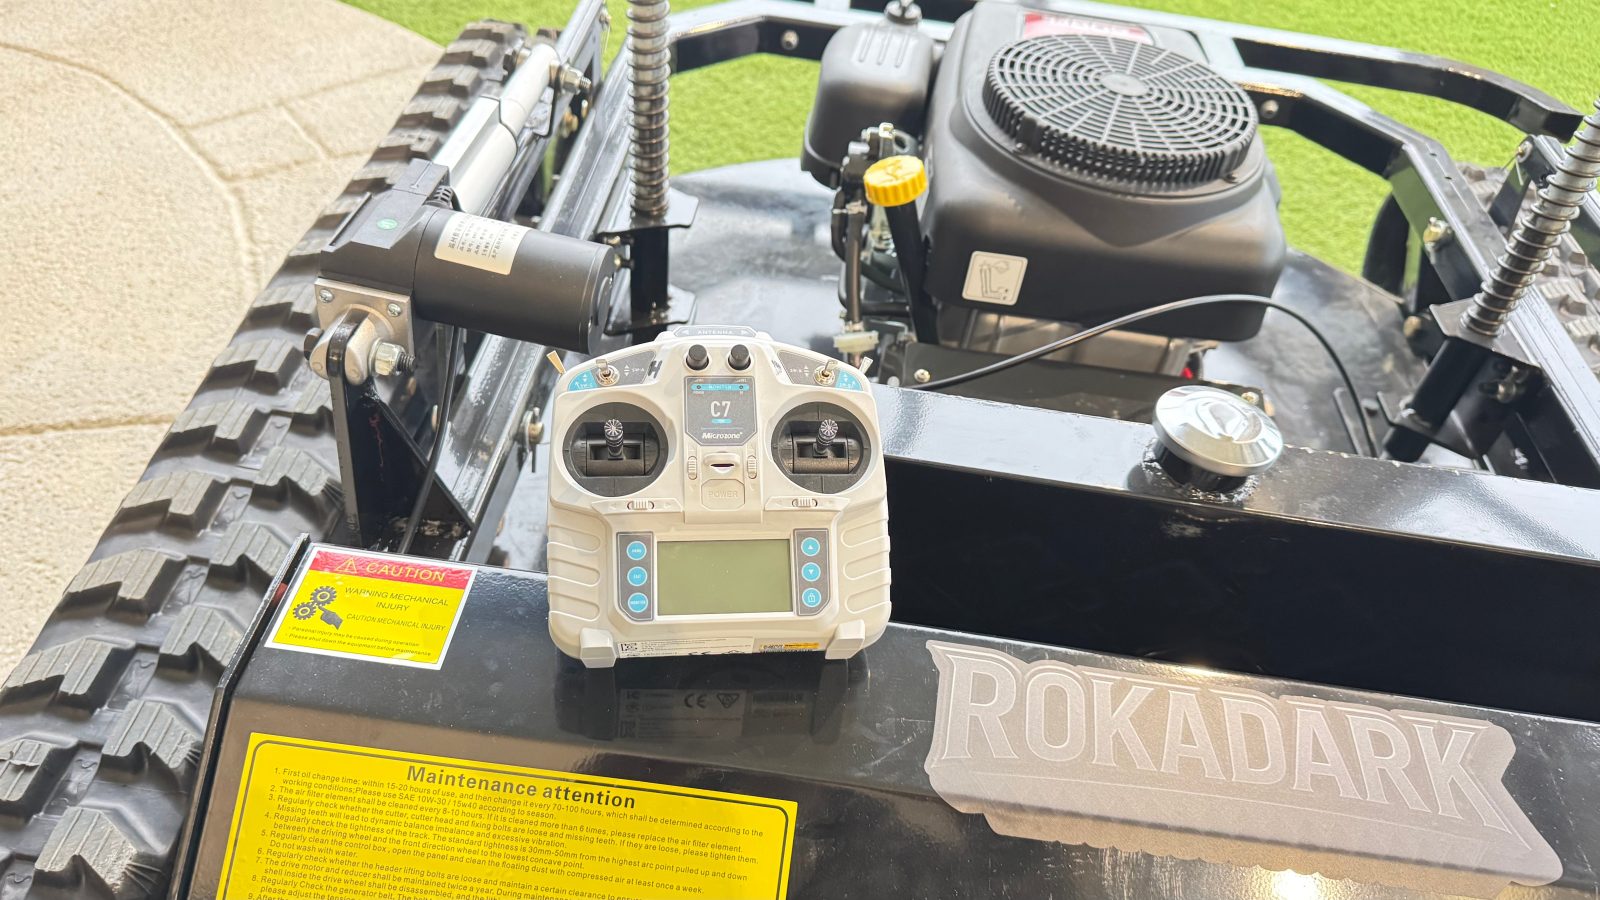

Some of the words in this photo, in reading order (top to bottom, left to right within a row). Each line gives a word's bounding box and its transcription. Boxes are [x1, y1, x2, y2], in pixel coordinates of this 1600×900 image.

[711, 401, 731, 417] C7
[708, 490, 738, 498] POWER
[366, 563, 446, 582] CAUTION
[344, 586, 388, 598] WARNING
[388, 592, 448, 606] MECHANICAL
[375, 601, 410, 611] INJURY
[346, 613, 376, 622] CAUTION
[376, 617, 419, 628] MECHANICAL
[419, 622, 446, 631] INJURY
[941, 651, 1512, 834] ROKADARK
[282, 778, 312, 789] working
[397, 792, 415, 801] SAE
[478, 803, 516, 816] according
[517, 807, 525, 815] to
[282, 768, 300, 777] First
[311, 772, 340, 783] change
[361, 779, 384, 788] within
[386, 781, 408, 791] 15-20
[408, 784, 431, 794] hours
[432, 787, 440, 795] of
[474, 793, 492, 802] then
[492, 795, 521, 807] change
[528, 801, 551, 811] every
[552, 803, 579, 813] 70-100
[605, 810, 627, 819] which
[628, 812, 647, 822] shall
[648, 815, 658, 823] be
[658, 817, 702, 829] determined
[703, 823, 740, 835] according
[742, 827, 749, 835] to
[751, 828, 763, 836] the
[406, 765, 537, 796] Maintenance
[542, 785, 635, 808] attention
[276, 804, 306, 816] Missing
[307, 808, 327, 816] teeth
[328, 811, 342, 819] will
[342, 812, 360, 821] lead
[369, 816, 402, 827] dynamic
[403, 820, 434, 831] balance
[435, 824, 474, 836] imbalance
[491, 833, 530, 843] excessive
[276, 795, 314, 807] Regularly
[314, 800, 338, 809] check
[339, 803, 370, 813] whether
[371, 807, 383, 815] the
[410, 813, 433, 821] cutter
[434, 815, 453, 824] head
[470, 819, 491, 831] fixing
[492, 822, 511, 831] bolts
[526, 827, 548, 836] loose
[564, 832, 594, 844] missing
[626, 839, 643, 850] they
[682, 847, 708, 858] please
[709, 850, 735, 861] tighten
[279, 786, 294, 794] The
[306, 789, 324, 798] filter
[324, 792, 356, 802] element
[356, 796, 375, 805] shall
[376, 798, 386, 806] be
[387, 800, 418, 810] cleaned
[418, 805, 441, 815] every
[442, 807, 459, 816] 8-10
[486, 812, 493, 820] If
[493, 813, 499, 821] it
[499, 814, 506, 822] is
[507, 815, 538, 826] cleaned
[539, 821, 559, 829] more
[560, 822, 577, 831] than
[578, 824, 584, 832] 6
[609, 829, 636, 839] please
[637, 833, 665, 843] replace
[666, 836, 679, 844] the
[692, 839, 709, 848] filter
[273, 812, 310, 826] Regularly
[311, 817, 334, 827] check
[335, 820, 348, 828] the
[349, 822, 384, 833] tightness
[385, 827, 394, 835] of
[394, 828, 407, 836] the
[432, 833, 446, 842] The
[447, 836, 482, 846] standard
[483, 839, 518, 851] tightness
[519, 844, 526, 852] is
[527, 845, 578, 858] 30mm-50mm
[578, 852, 596, 861] from
[597, 855, 610, 863] the
[611, 856, 640, 867] highest
[654, 863, 674, 871] point
[674, 865, 699, 874] pulled
[699, 869, 710, 877] up
[726, 871, 747, 880] down
